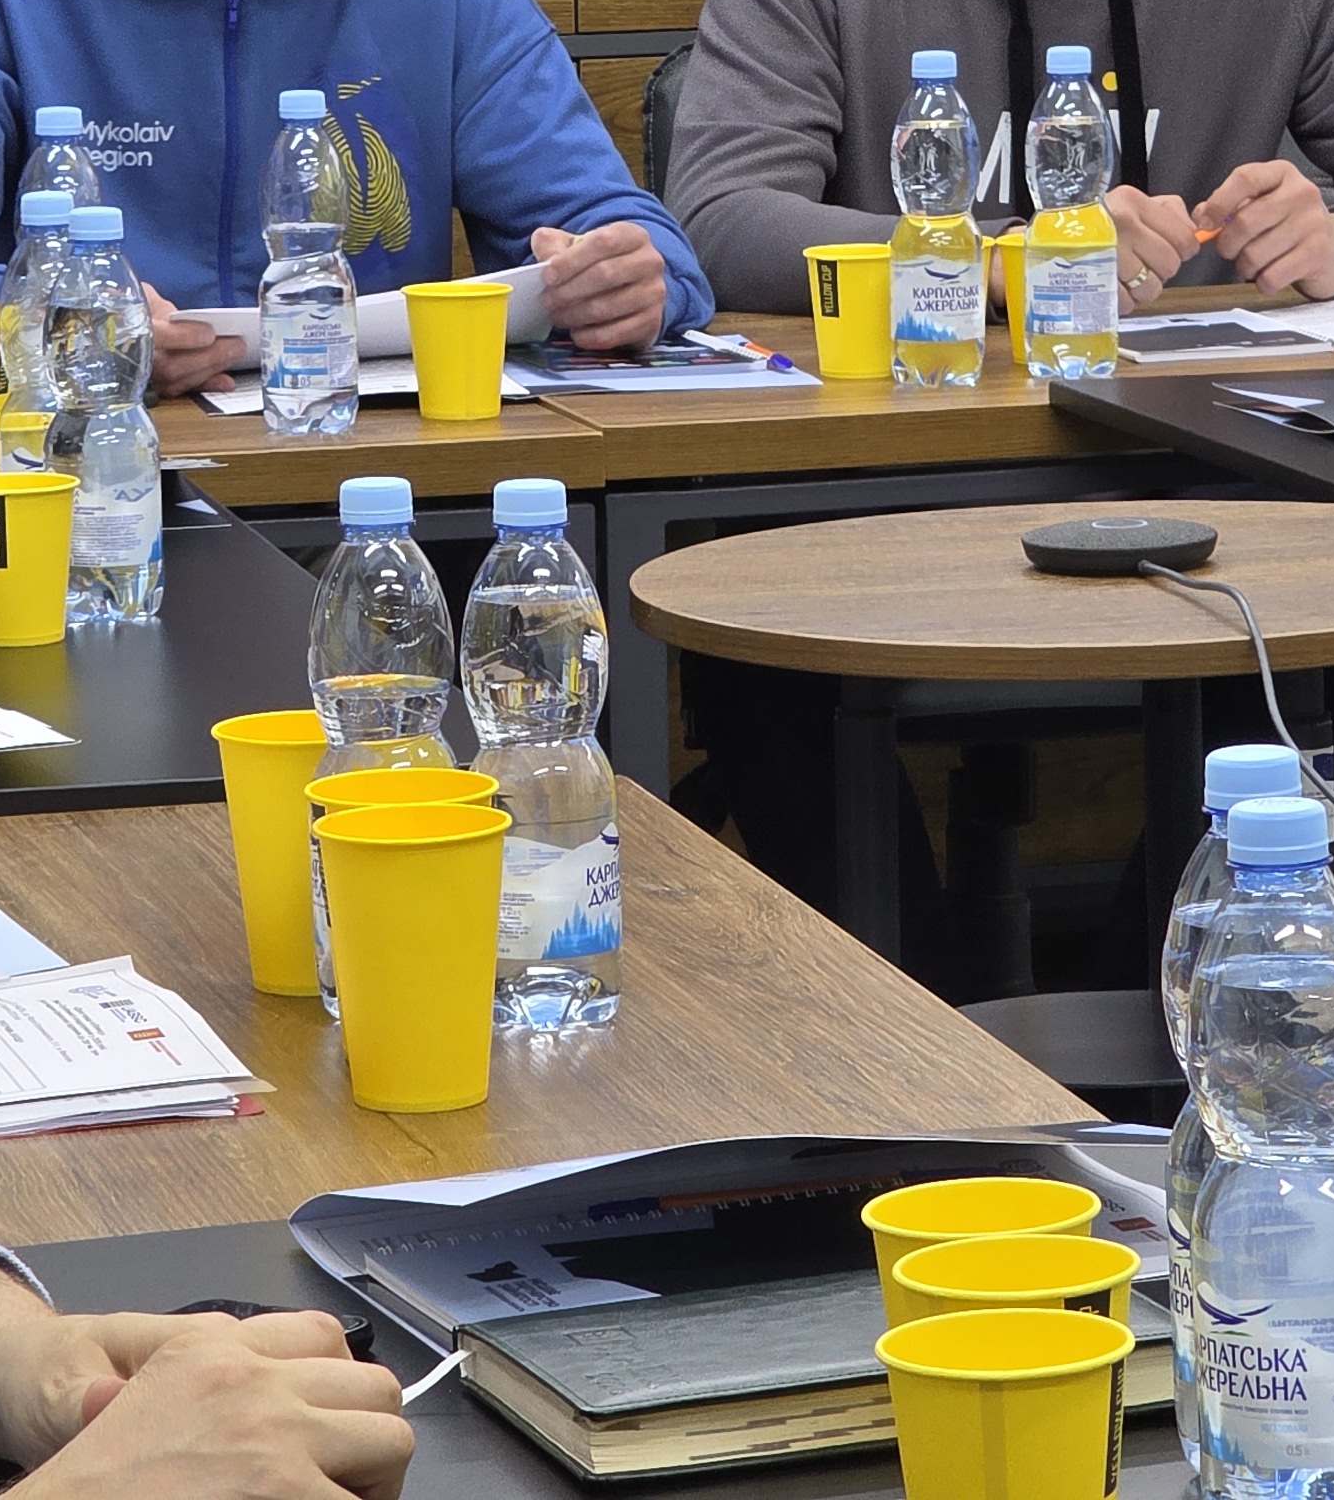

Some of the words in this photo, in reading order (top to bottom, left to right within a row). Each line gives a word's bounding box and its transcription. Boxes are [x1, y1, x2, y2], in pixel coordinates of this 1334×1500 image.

[82, 120, 175, 147] Mykolaiv
[83, 145, 153, 172] egion
[586, 861, 620, 887] КАРП
[1197, 1334, 1309, 1373] РПАТСЬКА
